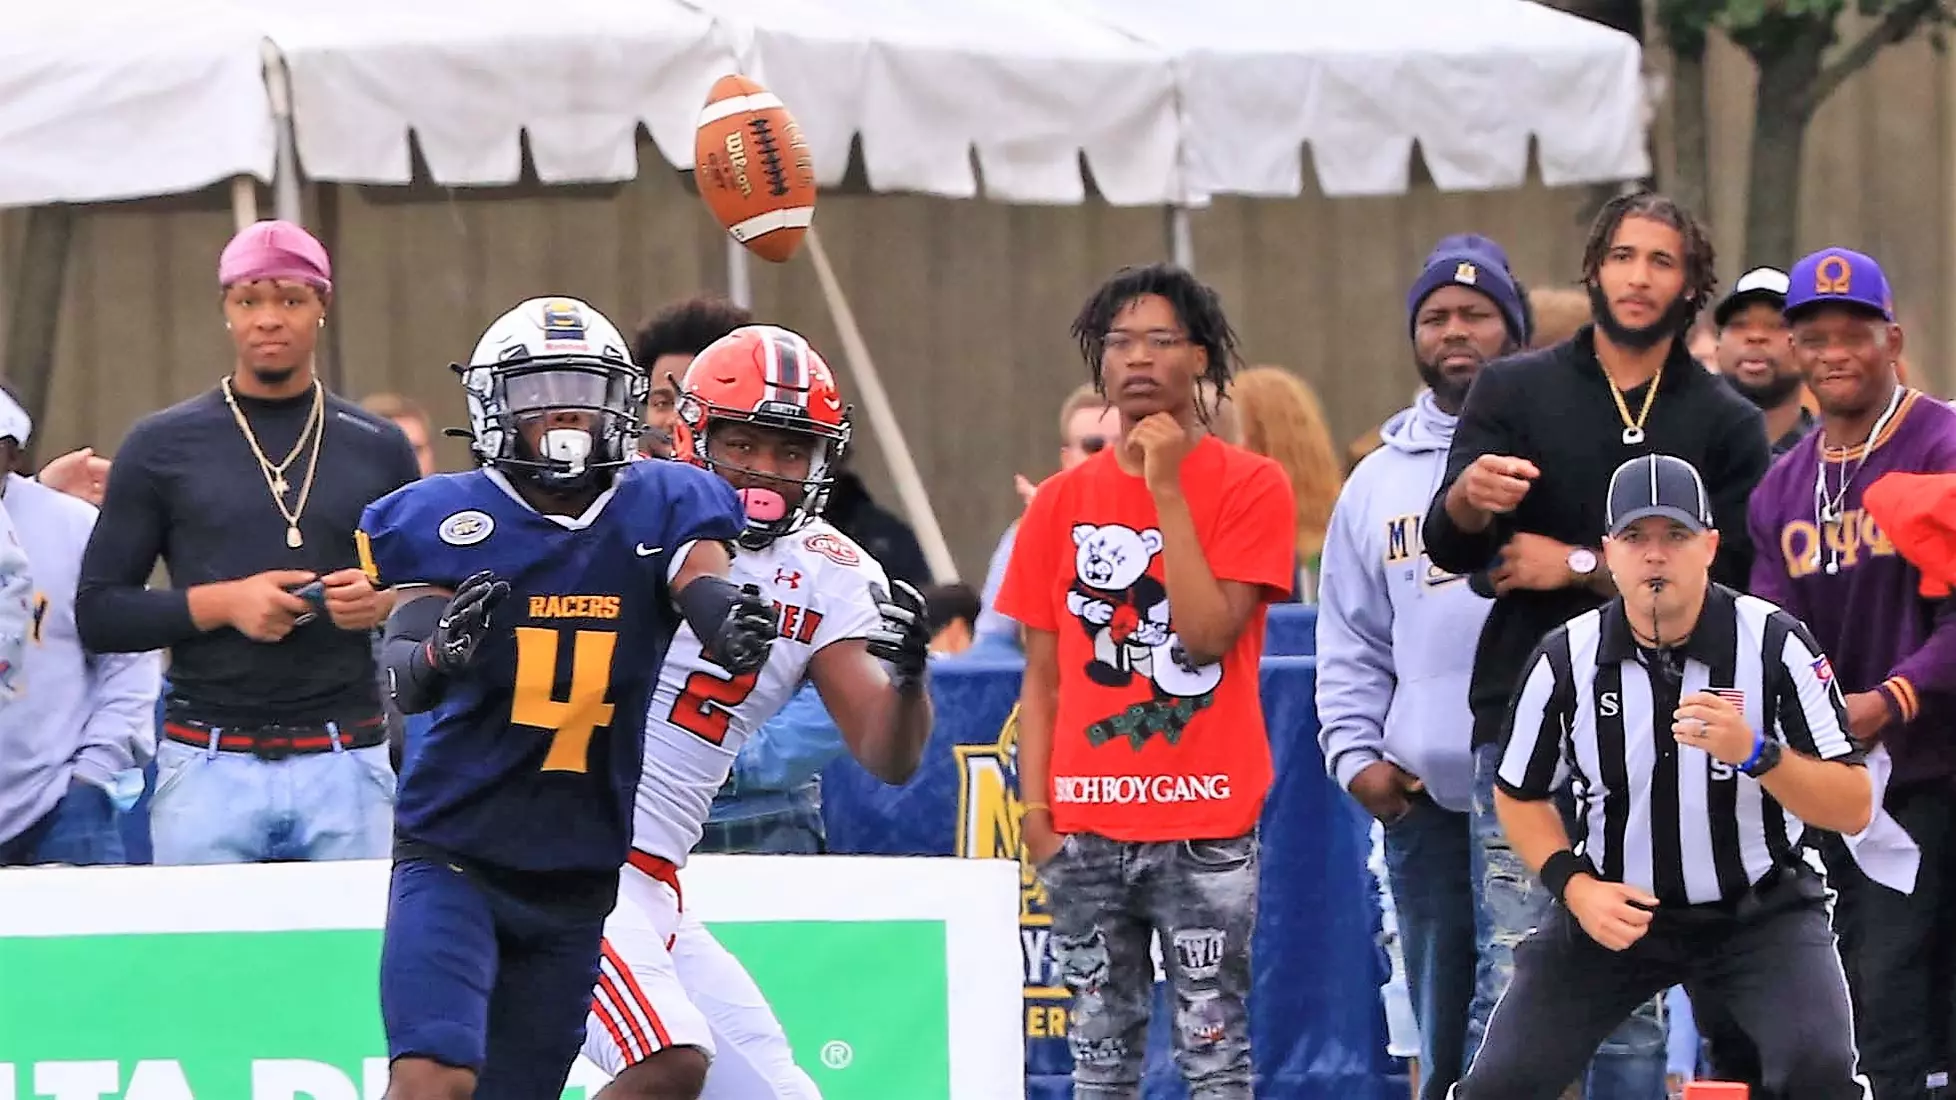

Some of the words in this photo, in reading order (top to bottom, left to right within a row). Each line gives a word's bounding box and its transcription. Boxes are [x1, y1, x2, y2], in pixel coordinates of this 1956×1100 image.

[529, 595, 621, 619] RACERS
[511, 626, 618, 774] 4
[667, 644, 760, 747] 2
